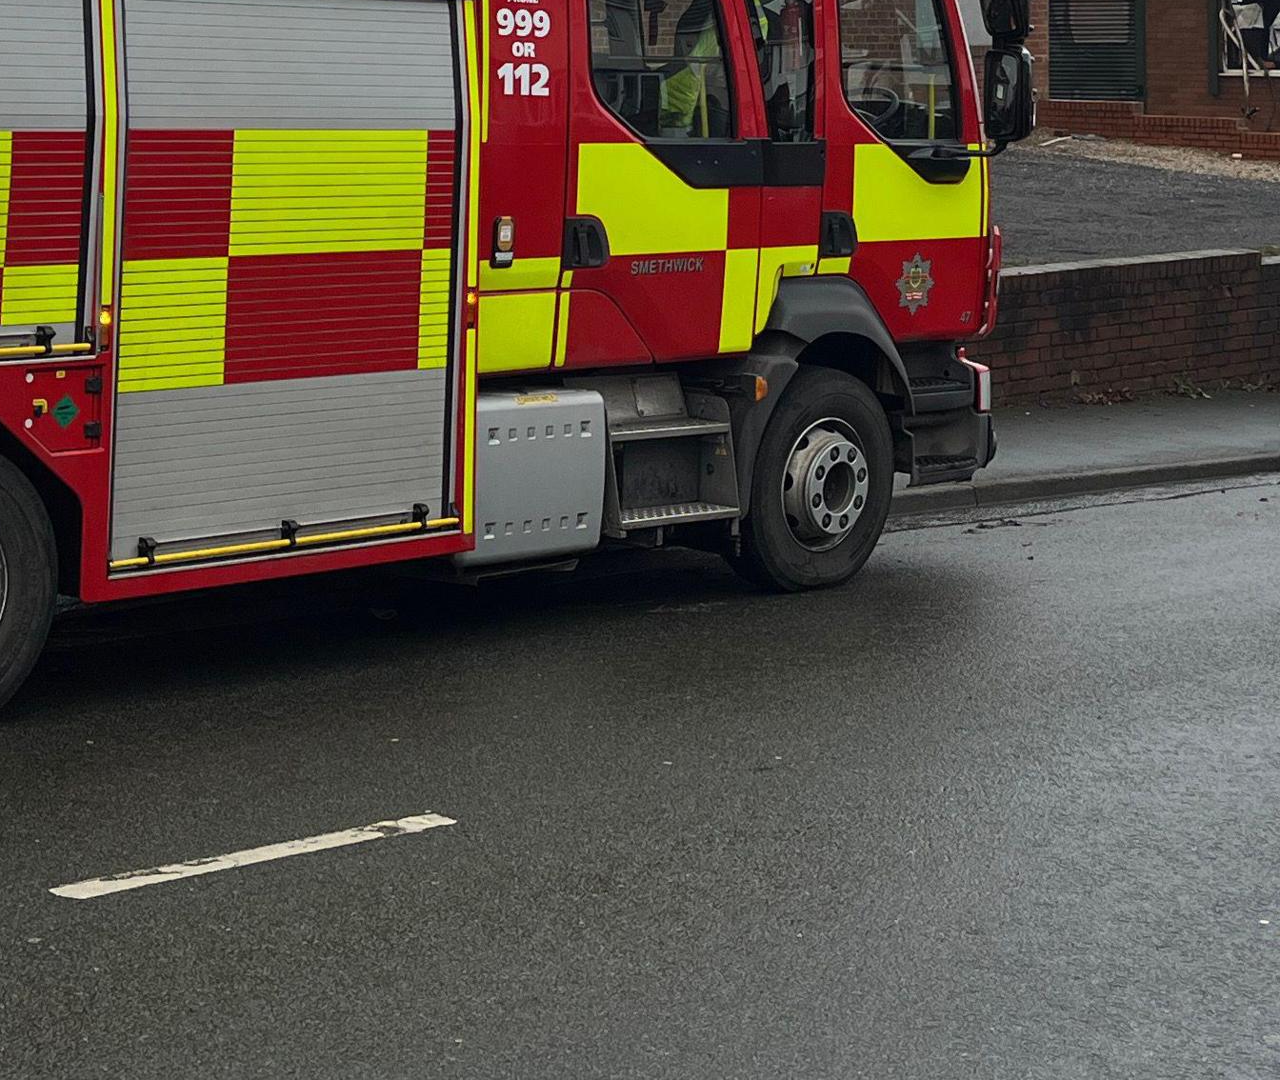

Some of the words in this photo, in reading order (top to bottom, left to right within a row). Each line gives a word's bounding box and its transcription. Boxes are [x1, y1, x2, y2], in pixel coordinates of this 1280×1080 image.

[496, 8, 551, 37] 999
[512, 41, 536, 57] OR
[497, 62, 550, 96] 112
[630, 257, 704, 275] SMETHWICK
